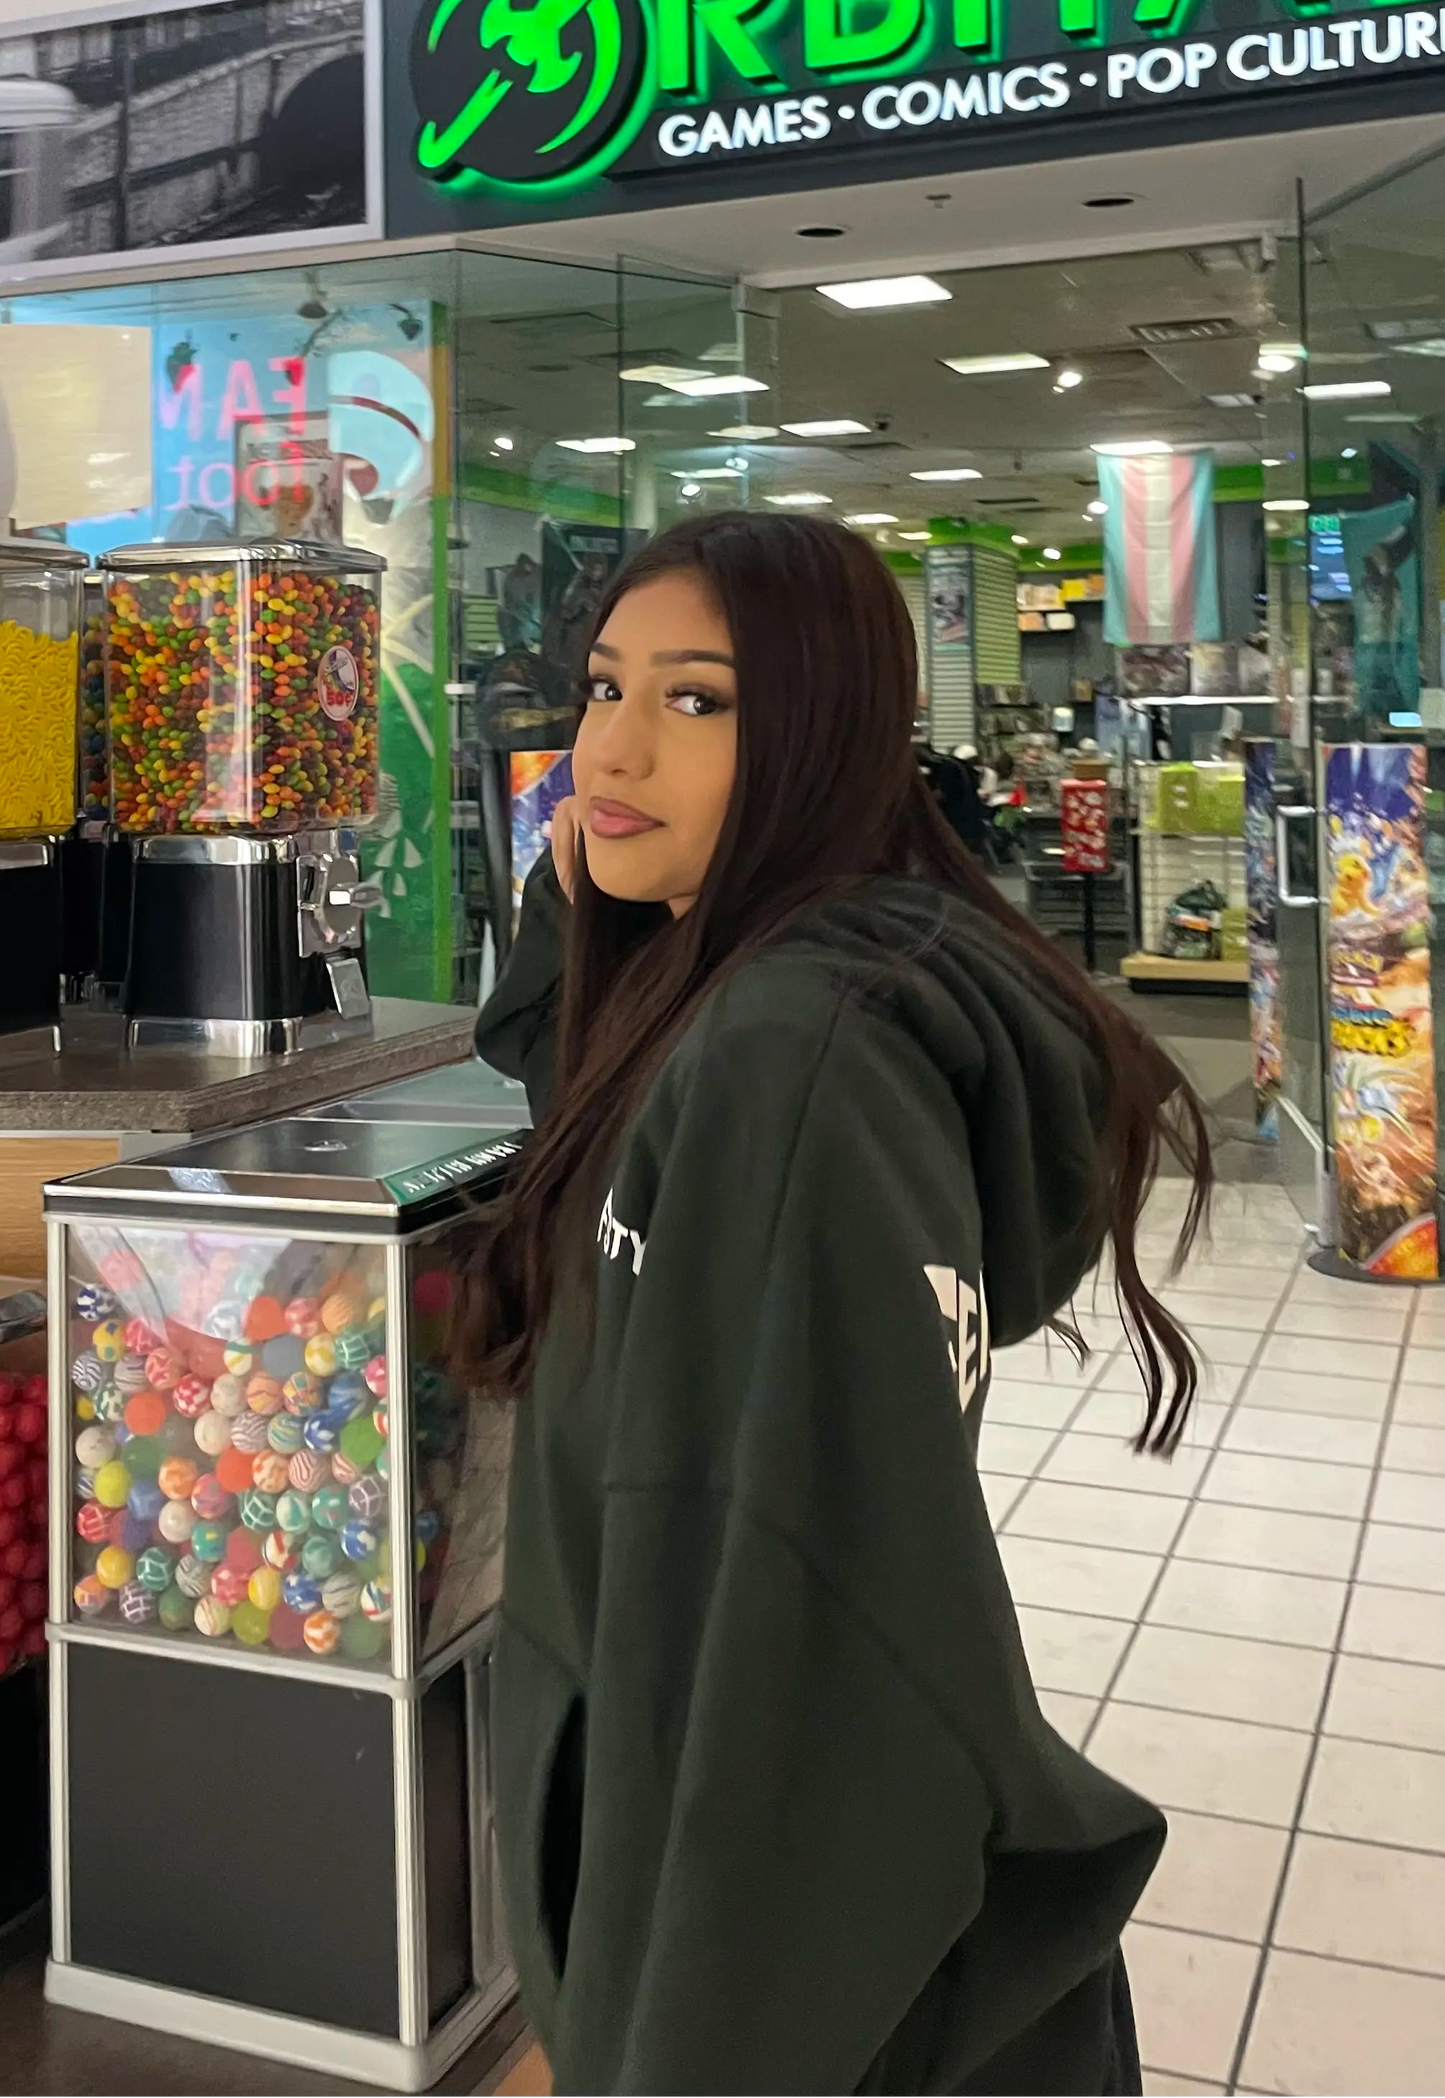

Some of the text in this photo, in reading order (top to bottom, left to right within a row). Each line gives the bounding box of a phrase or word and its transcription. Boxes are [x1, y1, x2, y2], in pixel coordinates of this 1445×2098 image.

[658, 95, 832, 158] GAMES
[862, 62, 1071, 131] COMICS
[1107, 42, 1218, 99] POP
[1226, 8, 1445, 81] CULTUR
